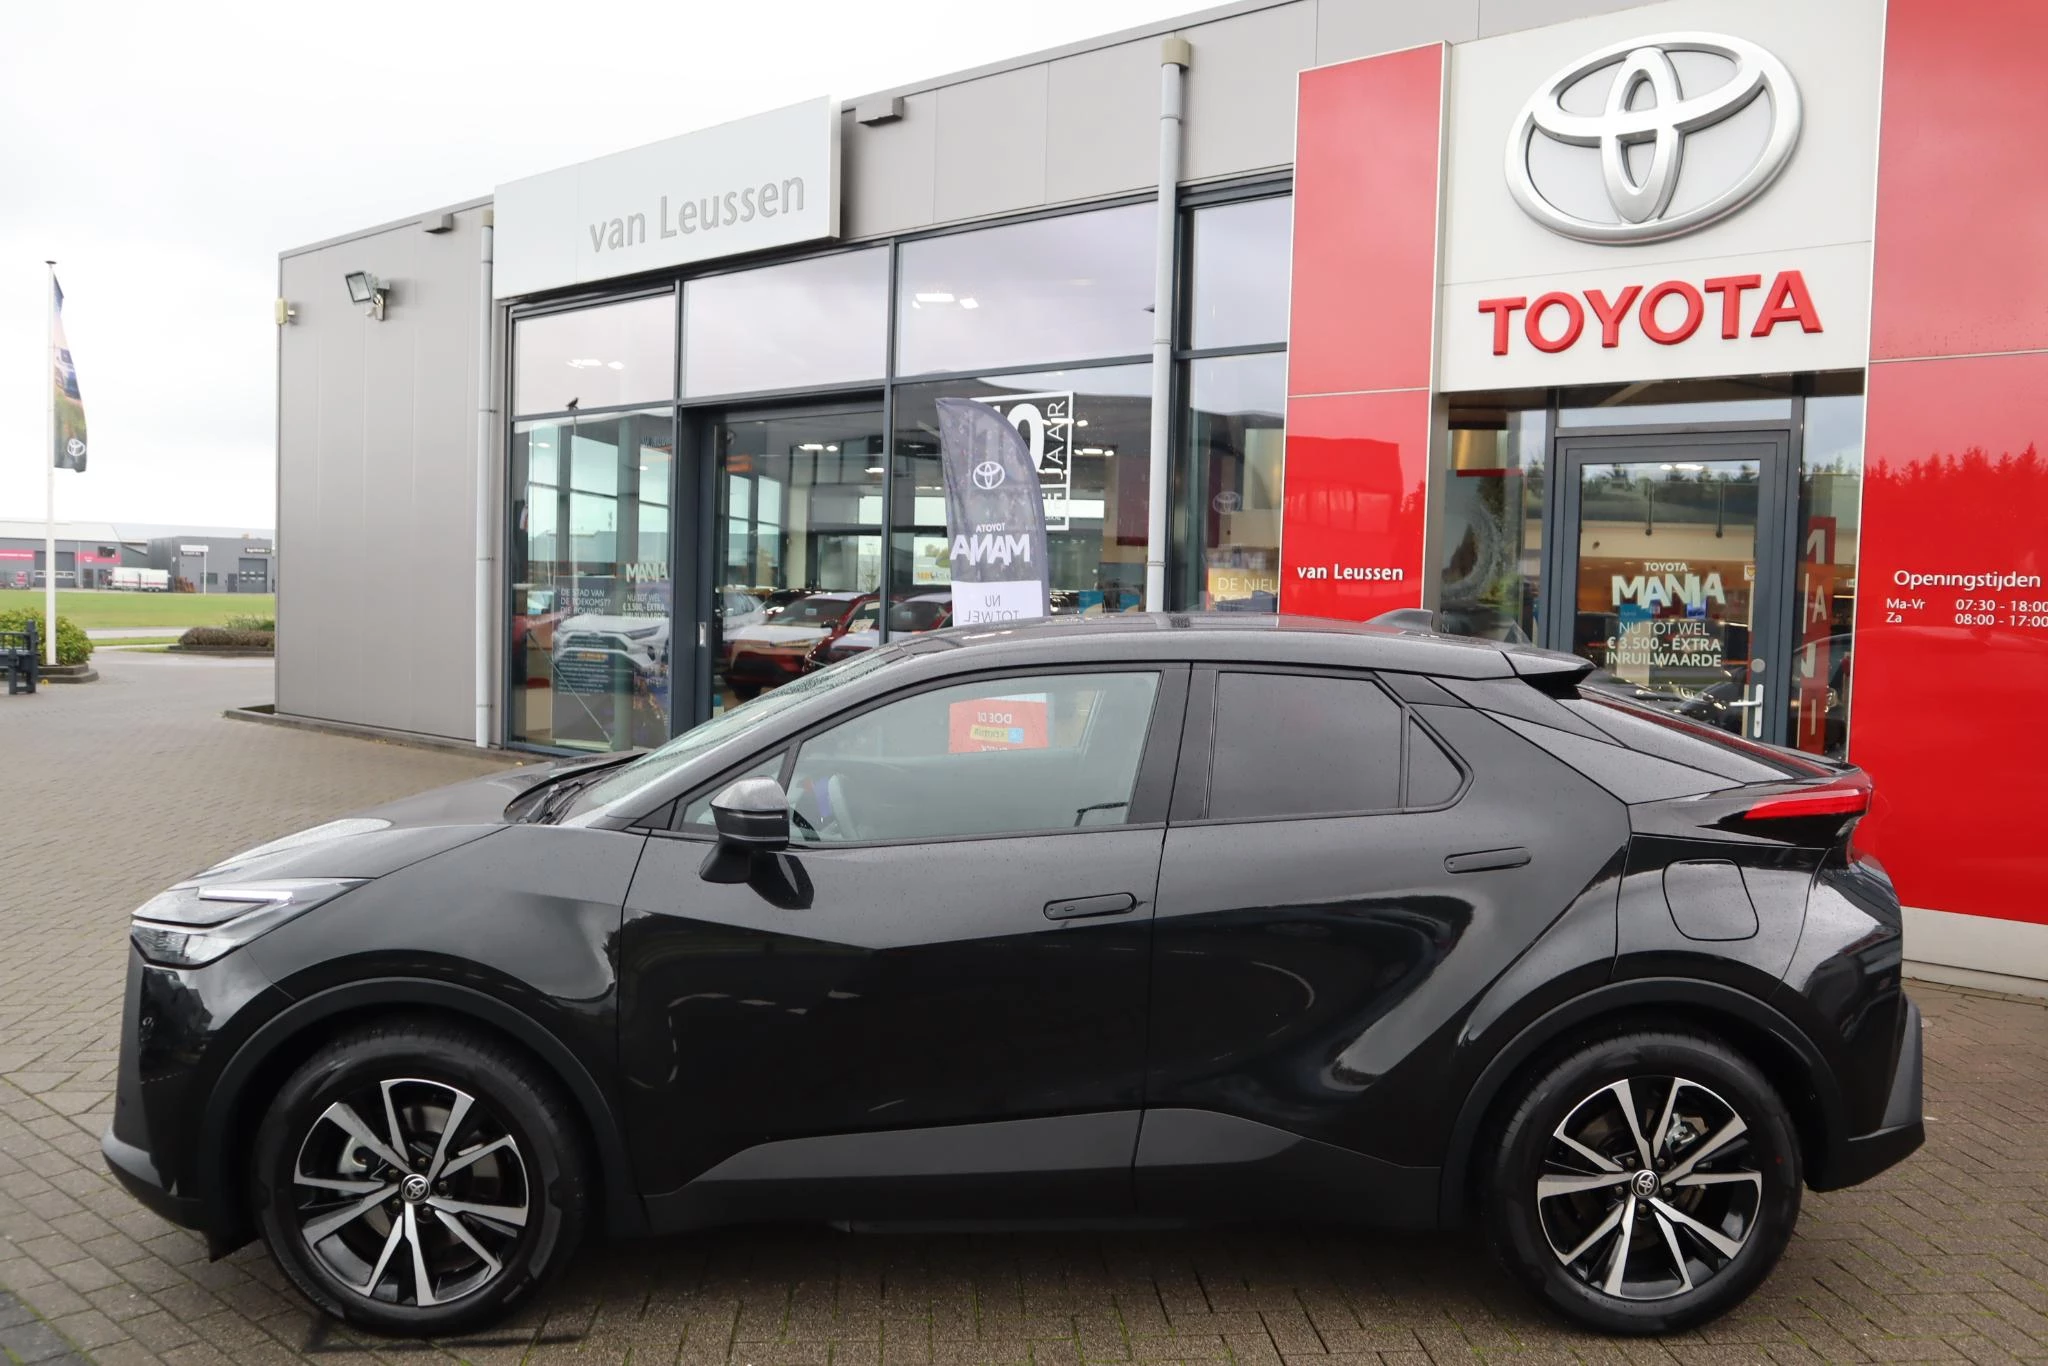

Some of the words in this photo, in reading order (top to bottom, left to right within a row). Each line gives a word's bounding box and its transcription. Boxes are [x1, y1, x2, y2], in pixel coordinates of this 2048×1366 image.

[589, 212, 646, 253] van
[660, 176, 804, 239] Leussen
[1478, 270, 1823, 356] TOYOTA
[1046, 400, 1066, 480] JAAR
[626, 562, 669, 584] MANIA
[1297, 566, 1328, 579] van
[1334, 563, 1404, 581] Leussen
[1644, 562, 1688, 572] TOYOTA
[1217, 577, 1239, 592] DE
[1894, 570, 2041, 592] Openingstijden
[1611, 572, 1726, 609] MANIA
[1886, 598, 1926, 610] Ma-Vr
[1956, 600, 1995, 611] 07:30
[2011, 601, 2048, 613] 18:00
[1886, 612, 1902, 623] Za
[1955, 614, 1994, 625] 08:00
[2010, 615, 2048, 628] 17:00
[1619, 622, 1641, 634] NU
[1646, 622, 1673, 635] TOT
[1678, 623, 1710, 636] WEL
[1607, 636, 1616, 649] €
[1606, 651, 1722, 667] INRUILWAARDE
